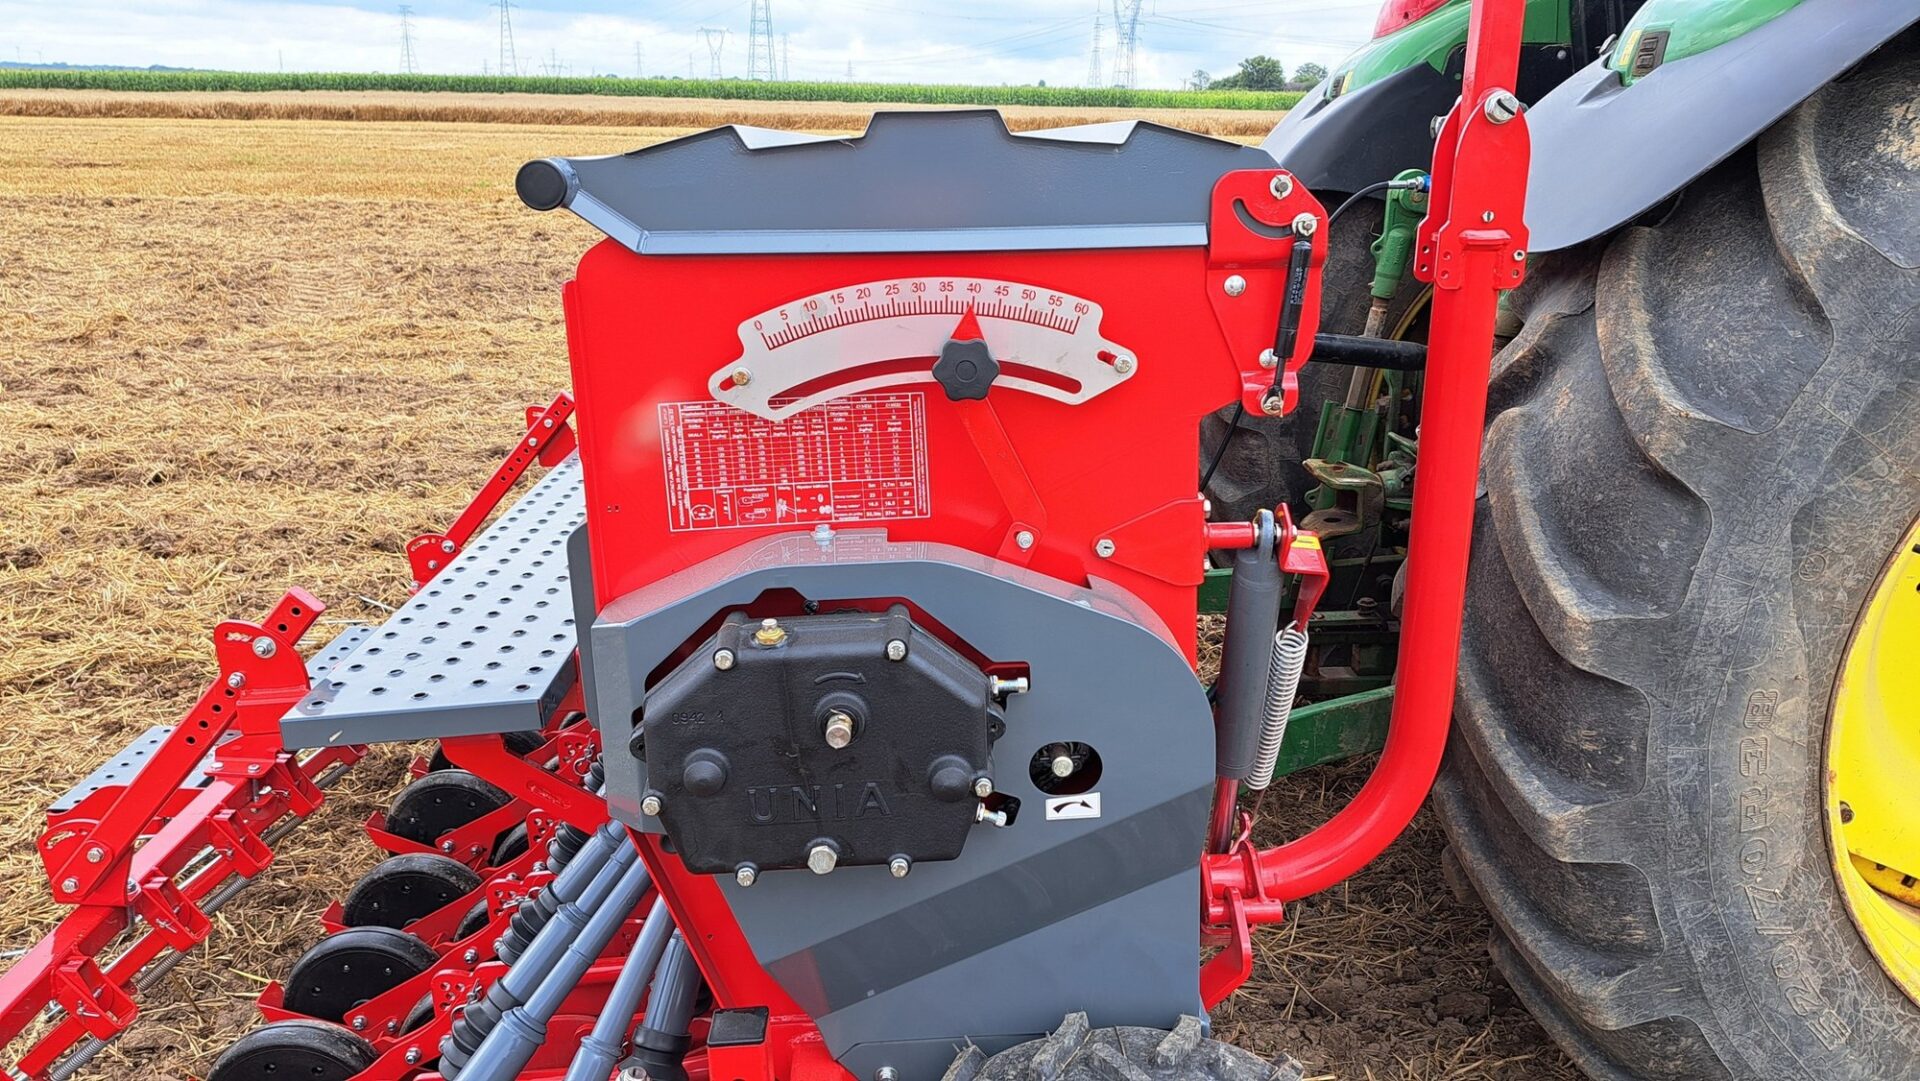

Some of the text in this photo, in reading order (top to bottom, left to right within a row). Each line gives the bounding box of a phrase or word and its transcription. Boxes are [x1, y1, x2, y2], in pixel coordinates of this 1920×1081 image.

[754, 281, 1090, 332] 0 5 10 15 20 25 30 35 40 45 50 55 60
[747, 782, 889, 823] UNIA
